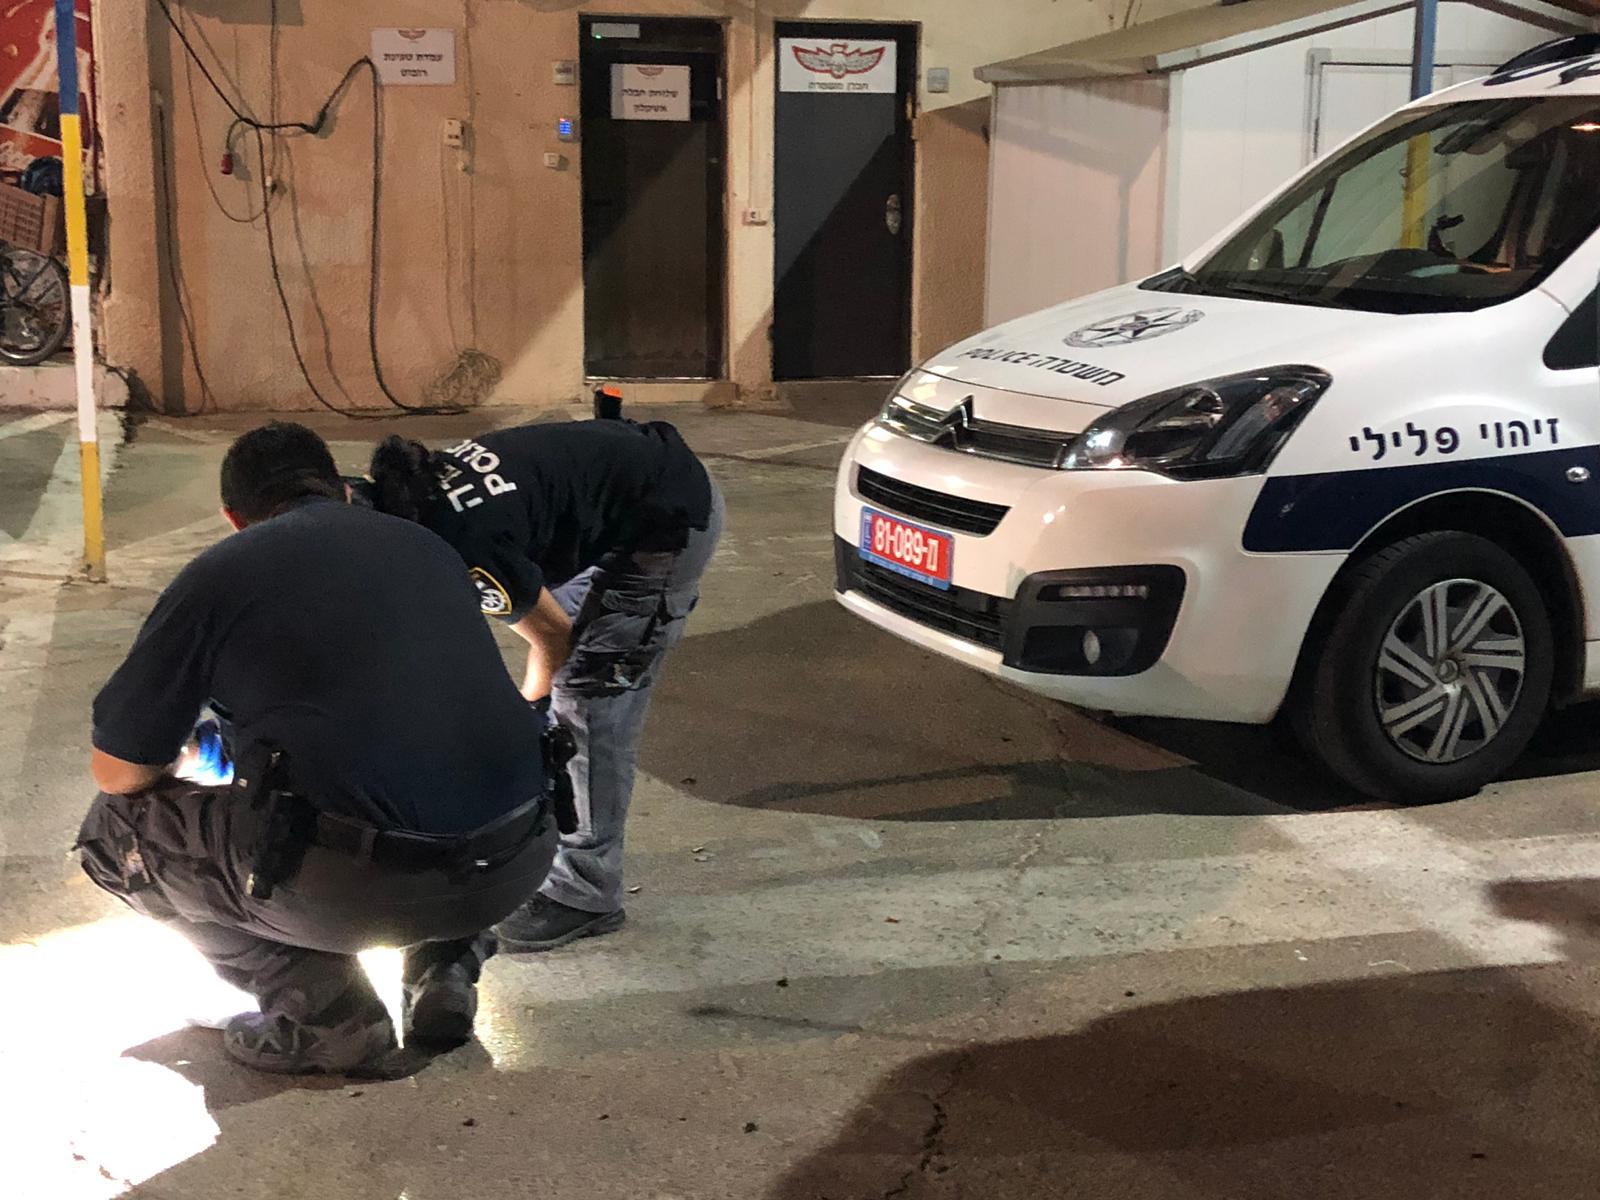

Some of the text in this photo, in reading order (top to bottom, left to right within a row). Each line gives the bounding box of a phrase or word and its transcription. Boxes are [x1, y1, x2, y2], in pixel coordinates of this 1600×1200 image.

[383, 53, 443, 62] עמדת טעינת
[956, 348, 1040, 364] POLICE
[1027, 356, 1126, 386] משטרה
[1349, 417, 1559, 461] זיהוי פלילי
[443, 439, 518, 497] POLIC
